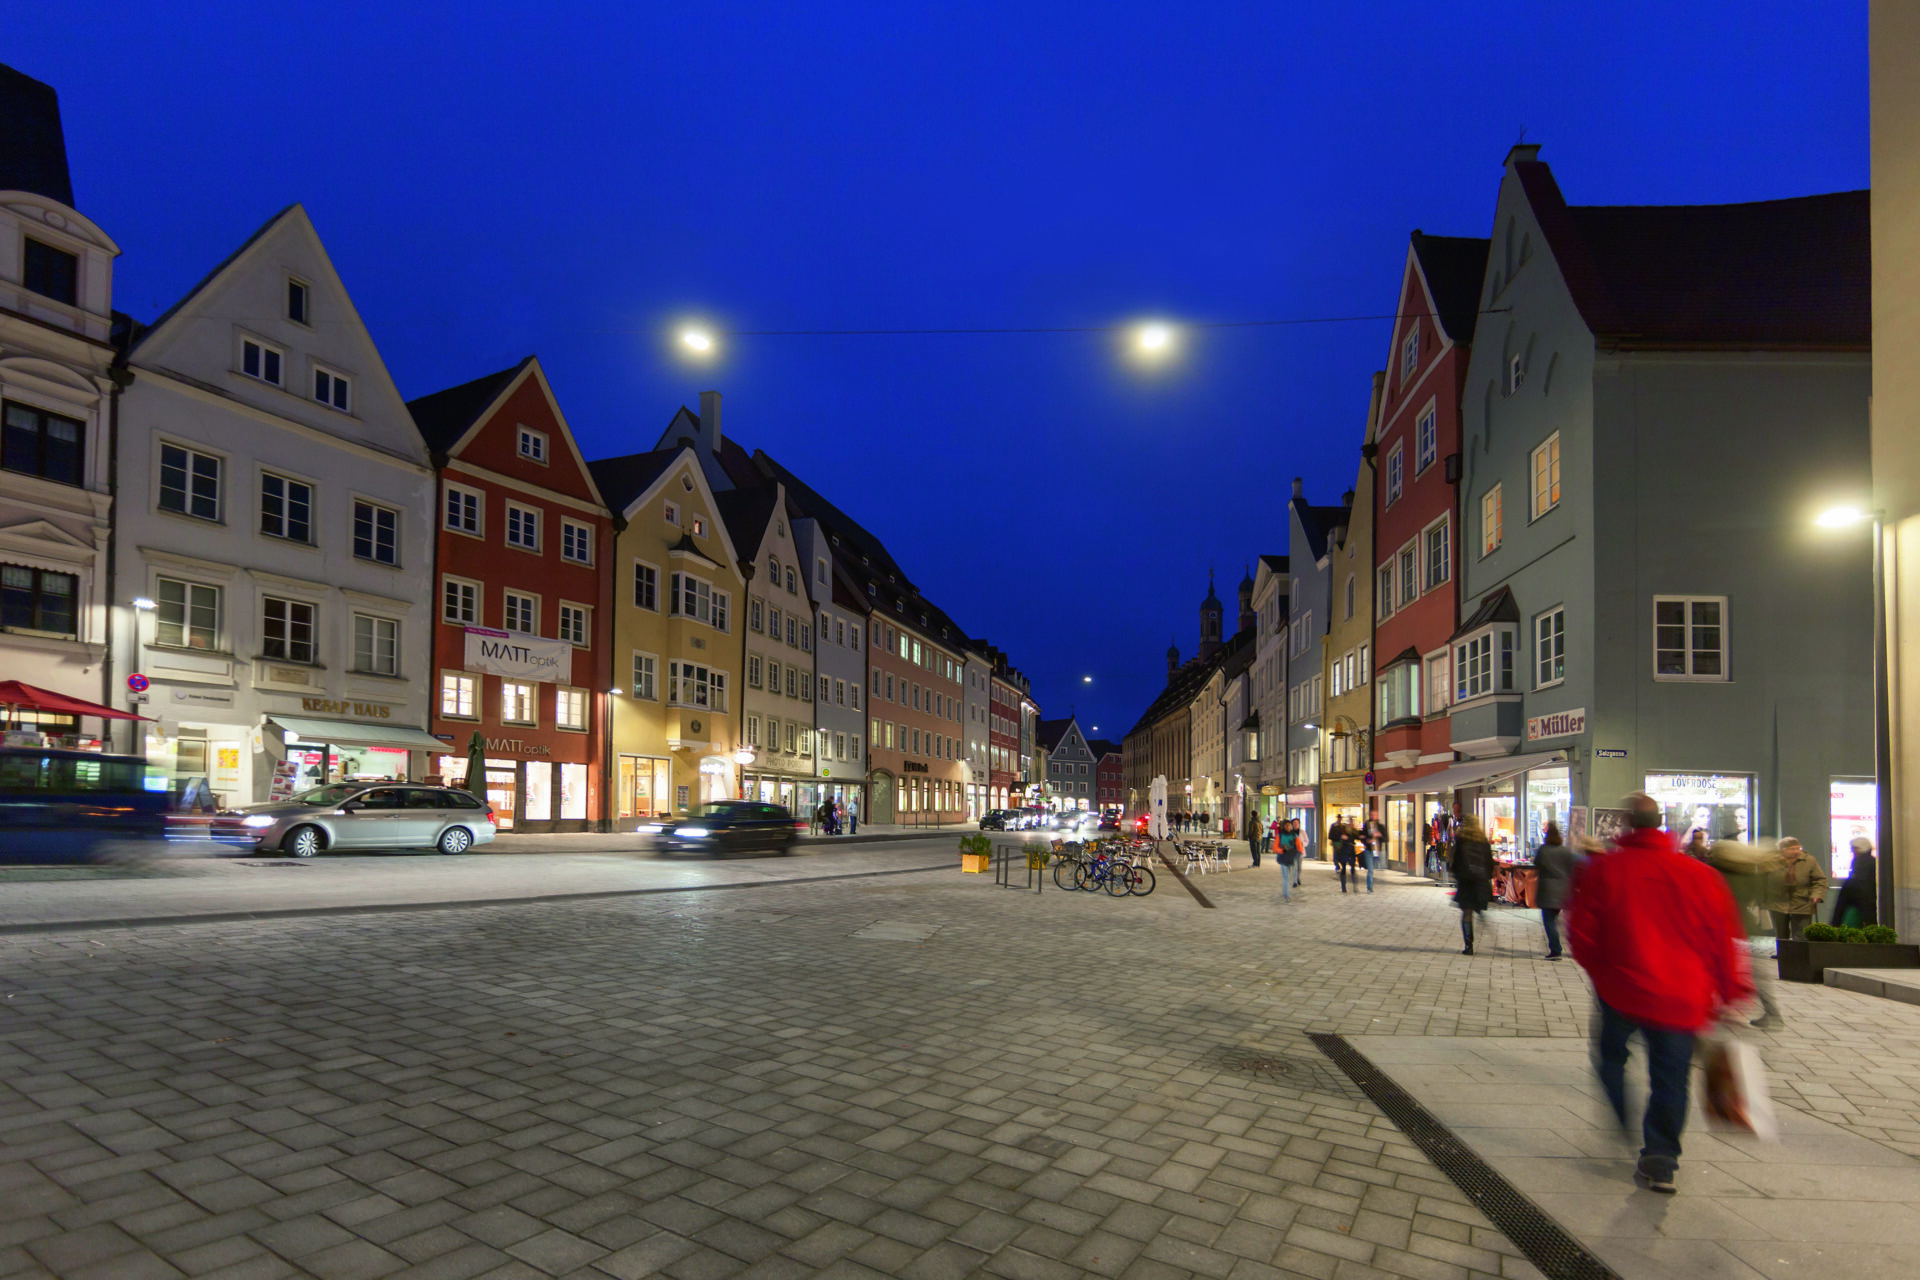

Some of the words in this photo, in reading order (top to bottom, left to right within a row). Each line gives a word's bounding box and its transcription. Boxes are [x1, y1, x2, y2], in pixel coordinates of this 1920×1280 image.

[482, 640, 530, 663] MATT
[530, 656, 559, 670] optik
[302, 697, 350, 714] KEBAP
[354, 703, 391, 718] HAUS
[1541, 714, 1584, 736] Müller
[486, 738, 524, 752] MATT
[523, 745, 551, 756] optik
